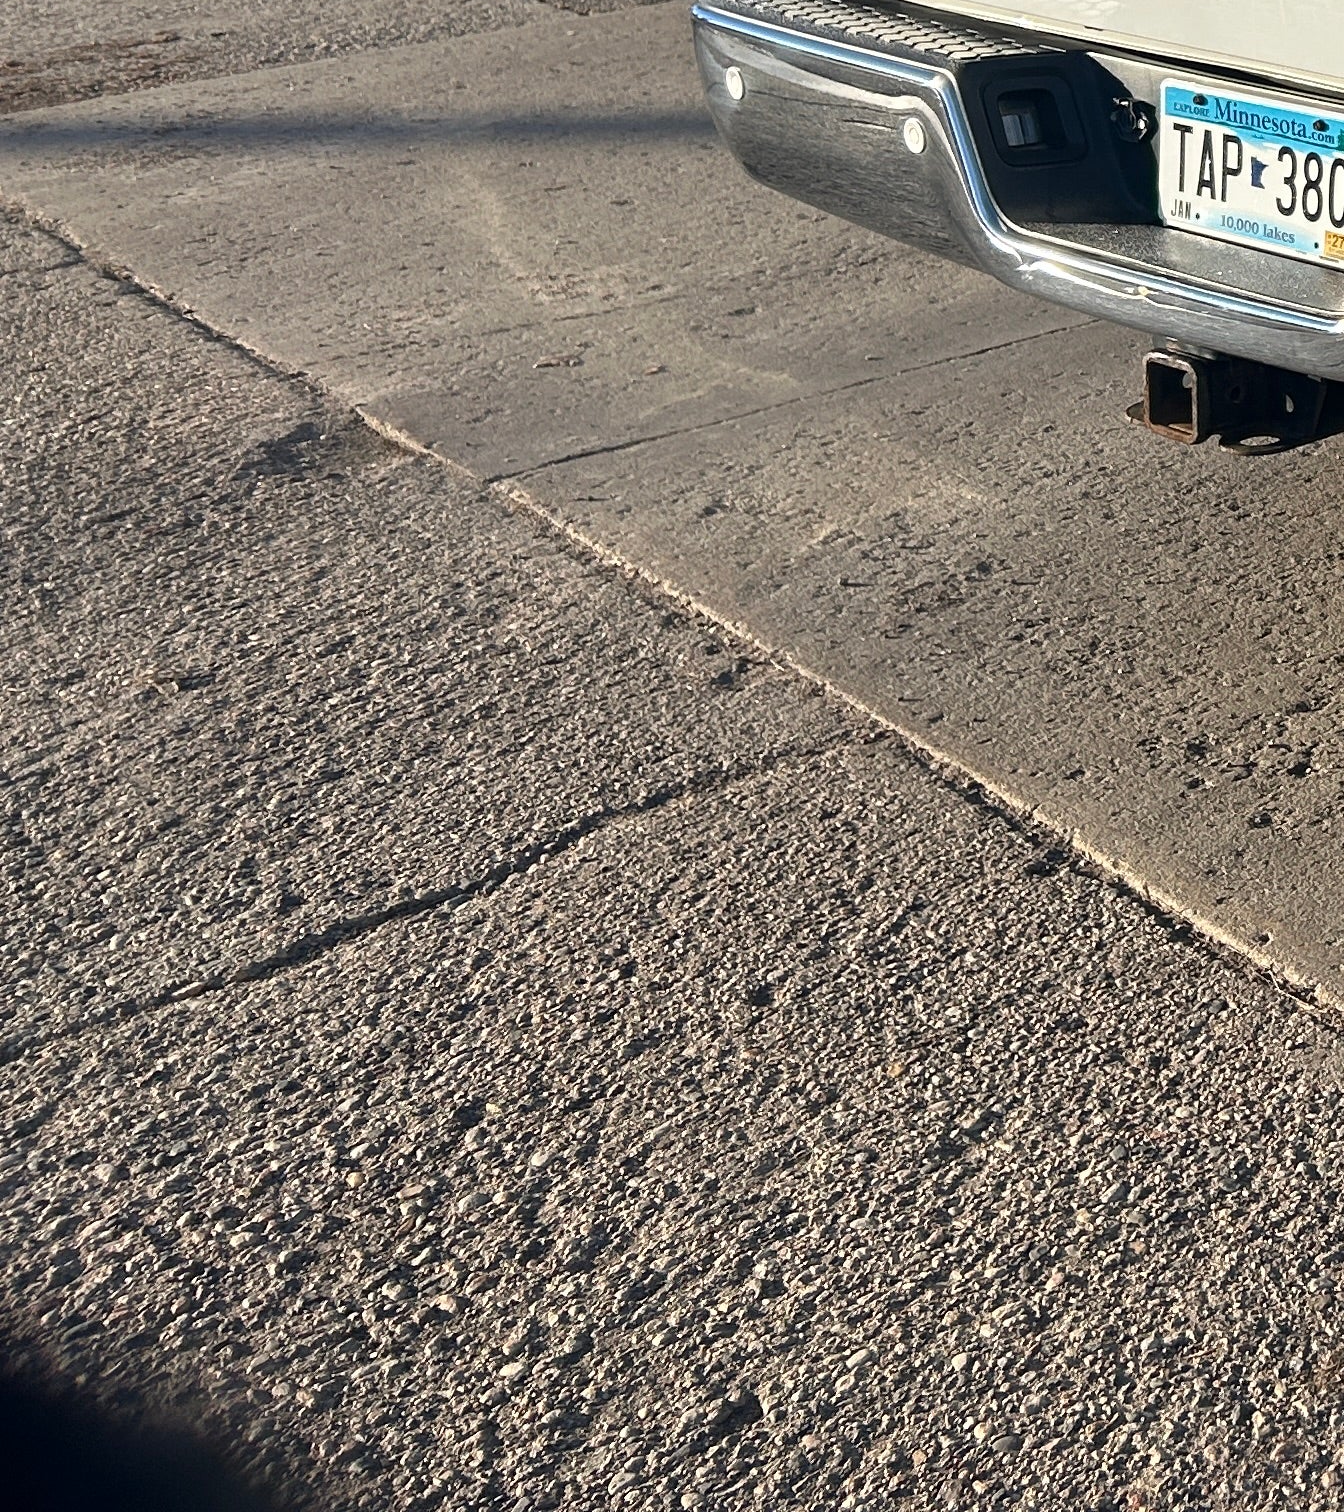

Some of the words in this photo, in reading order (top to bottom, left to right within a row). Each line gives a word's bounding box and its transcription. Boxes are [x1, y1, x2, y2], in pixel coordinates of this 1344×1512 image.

[1173, 102, 1210, 118] EXPLORE
[1173, 123, 1243, 203] TAP
[1171, 199, 1192, 221] JAN
[1220, 214, 1259, 236] 10,000
[1263, 224, 1296, 245] lakes
